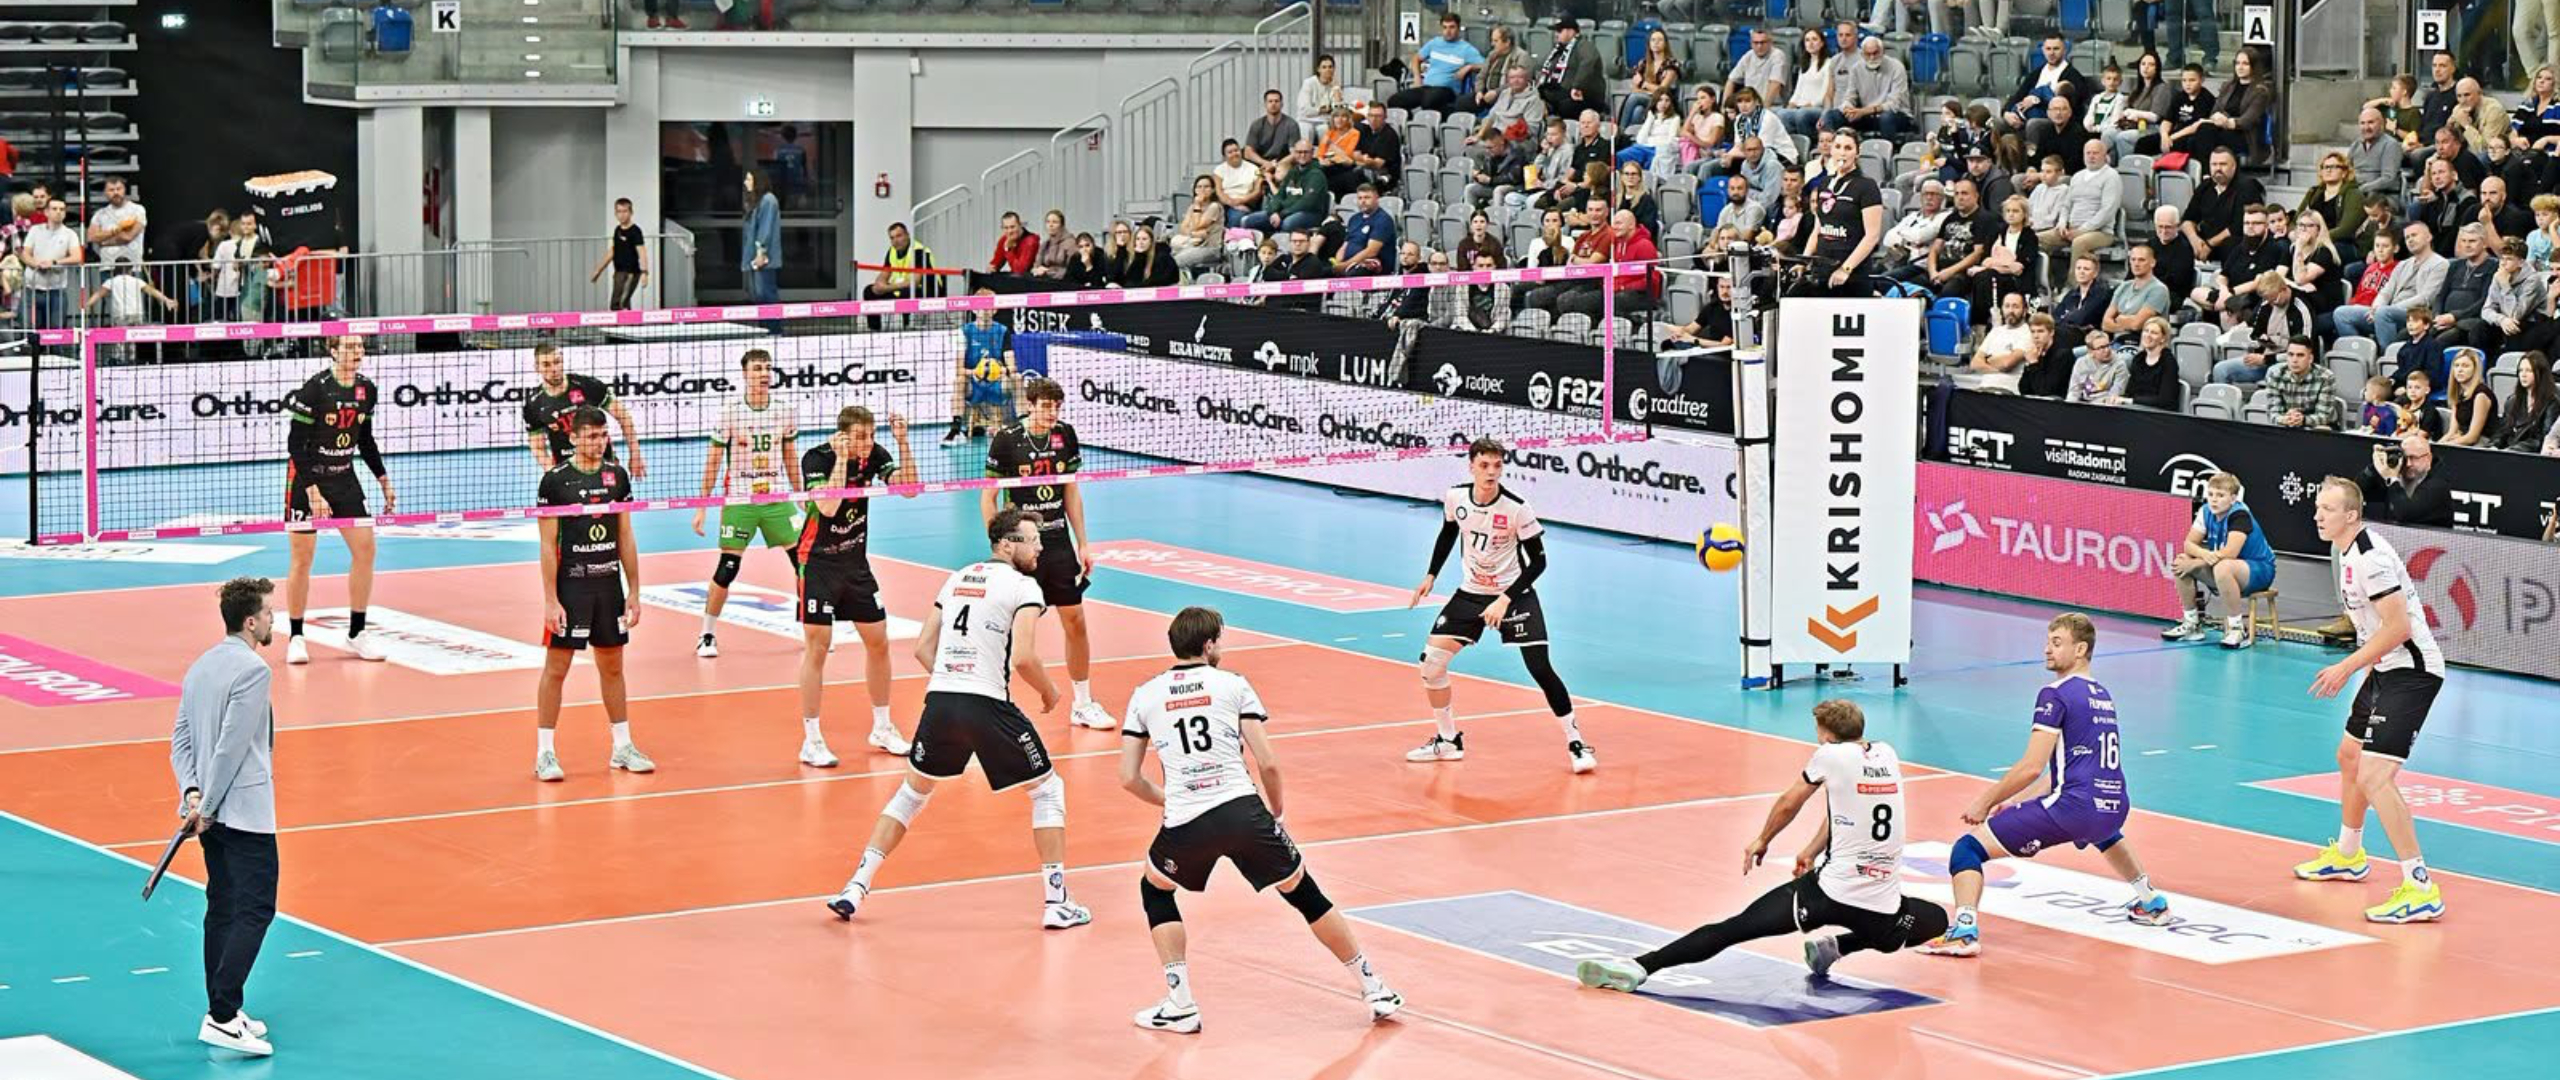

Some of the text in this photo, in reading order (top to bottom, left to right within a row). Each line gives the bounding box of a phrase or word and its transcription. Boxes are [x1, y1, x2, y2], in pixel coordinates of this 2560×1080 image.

[438, 10, 456, 29] K
[1404, 21, 1415, 41] A
[2249, 17, 2266, 40] A
[2423, 22, 2440, 46] B
[1028, 310, 1071, 333] SIEK
[1169, 340, 1233, 362] KRAWCZYK
[1289, 352, 1320, 376] mpk
[1340, 354, 1402, 388] LUM
[1465, 375, 1505, 394] radpec
[1081, 379, 1180, 415] OrthoCare.
[1650, 394, 1709, 418] radfrez
[338, 408, 356, 429] 17
[1196, 396, 1304, 434] OrthoCare.
[751, 433, 772, 452] 16
[1318, 413, 1428, 449] OrthoCare
[1826, 313, 1865, 590] KRISHOME
[2045, 449, 2127, 474] visitRadom.pl
[1577, 451, 1706, 495] OrthoCare.
[721, 525, 734, 539] 16
[1470, 530, 1489, 552] 77
[1990, 516, 2177, 581] TAURON
[807, 599, 818, 614] 8
[953, 604, 971, 638] 4
[1173, 715, 1212, 755] 13
[2098, 732, 2120, 770] 16
[1862, 765, 1892, 778] KOWAL
[1871, 803, 1893, 842] 8
[2022, 890, 2270, 945] radec
